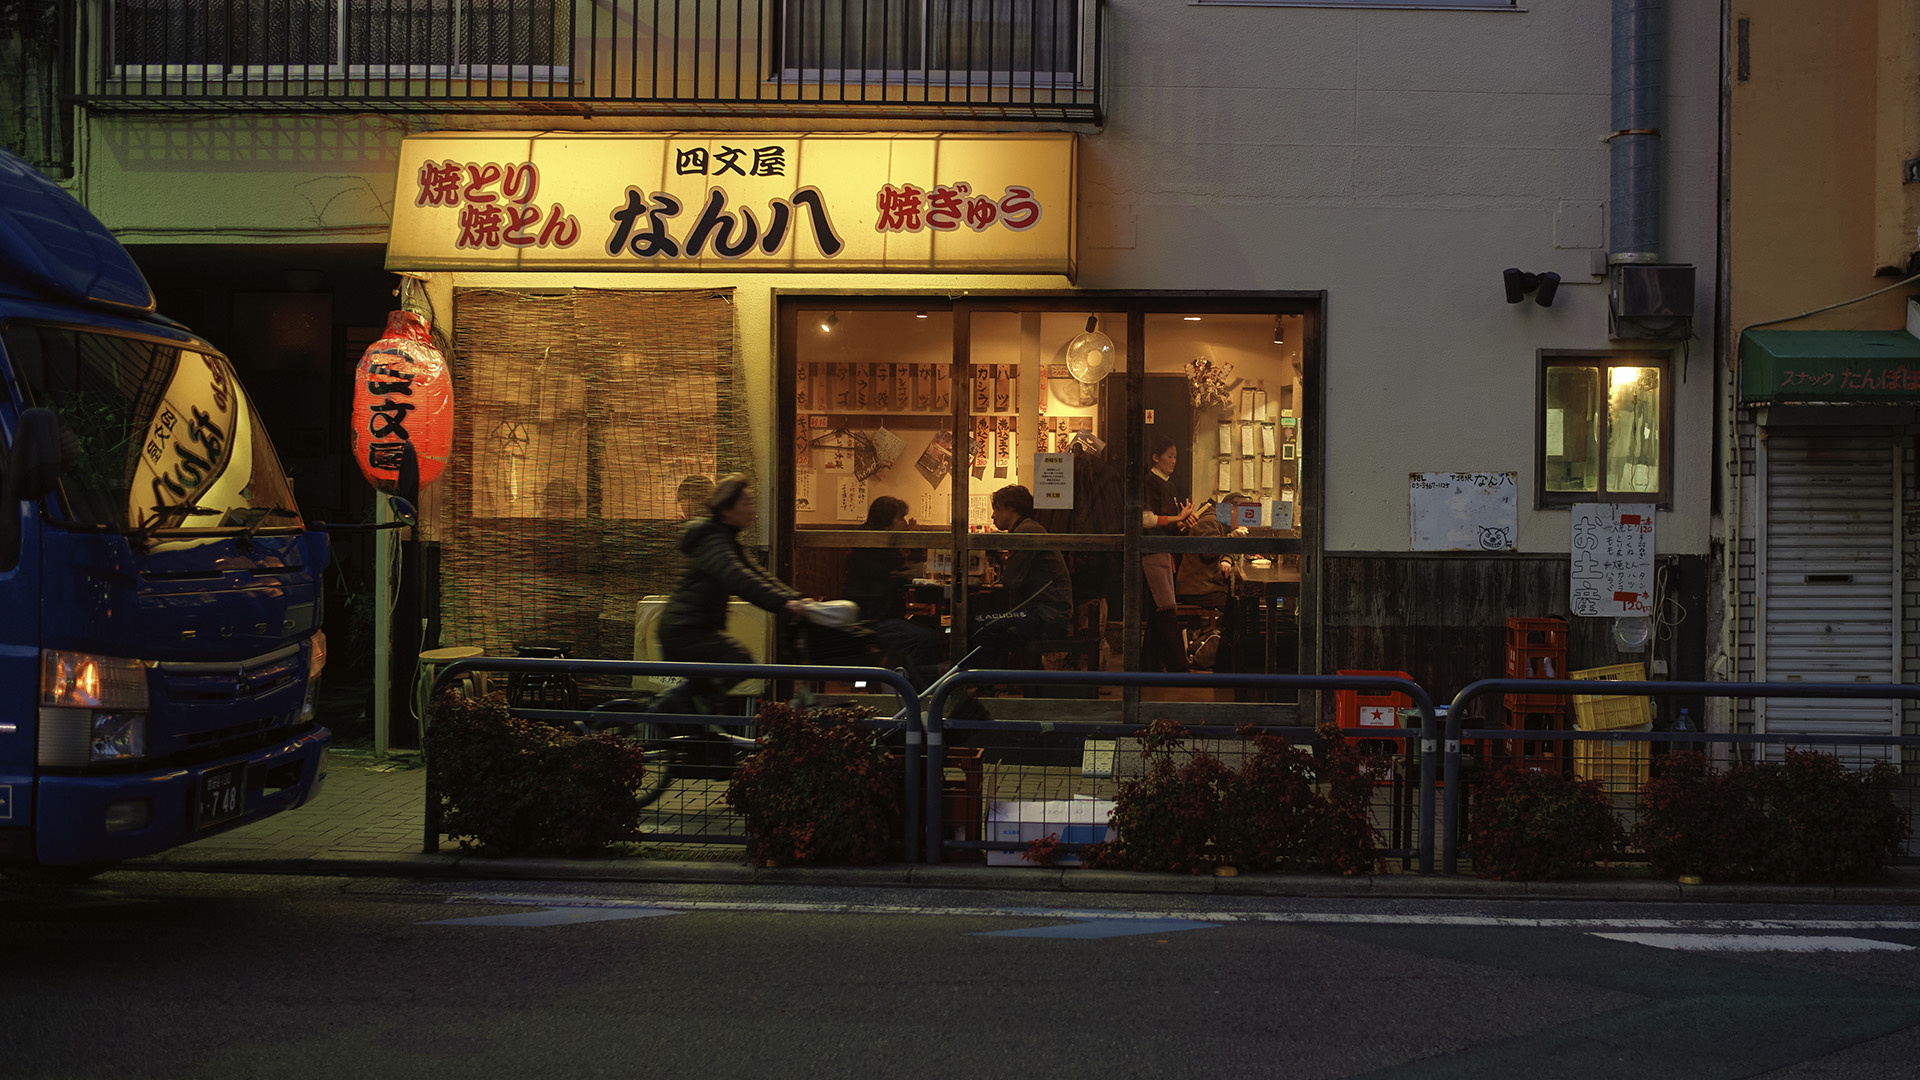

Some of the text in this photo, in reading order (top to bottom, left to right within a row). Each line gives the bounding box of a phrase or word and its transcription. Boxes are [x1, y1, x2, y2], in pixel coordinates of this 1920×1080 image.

[675, 146, 785, 177] 四文屋
[418, 161, 539, 206] 焼とり
[459, 204, 579, 248] 焼とん
[609, 186, 843, 258] なん八
[876, 183, 1041, 232] 焼ぎゅう
[797, 367, 807, 405] もも
[877, 368, 889, 408] 子袋
[936, 368, 949, 406] レバ
[977, 368, 989, 406] カシラ
[997, 369, 1010, 406] ハツ
[1781, 371, 1835, 387] スナック
[796, 417, 808, 454] キャベツ
[977, 418, 989, 459] 煮込ライス
[997, 417, 1009, 458] 煮込玉子
[1411, 474, 1427, 482] TEL
[1626, 534, 1634, 556] つくね
[1640, 526, 1653, 534] 120
[1572, 515, 1604, 616] お土産
[1612, 560, 1639, 571] 焼とん
